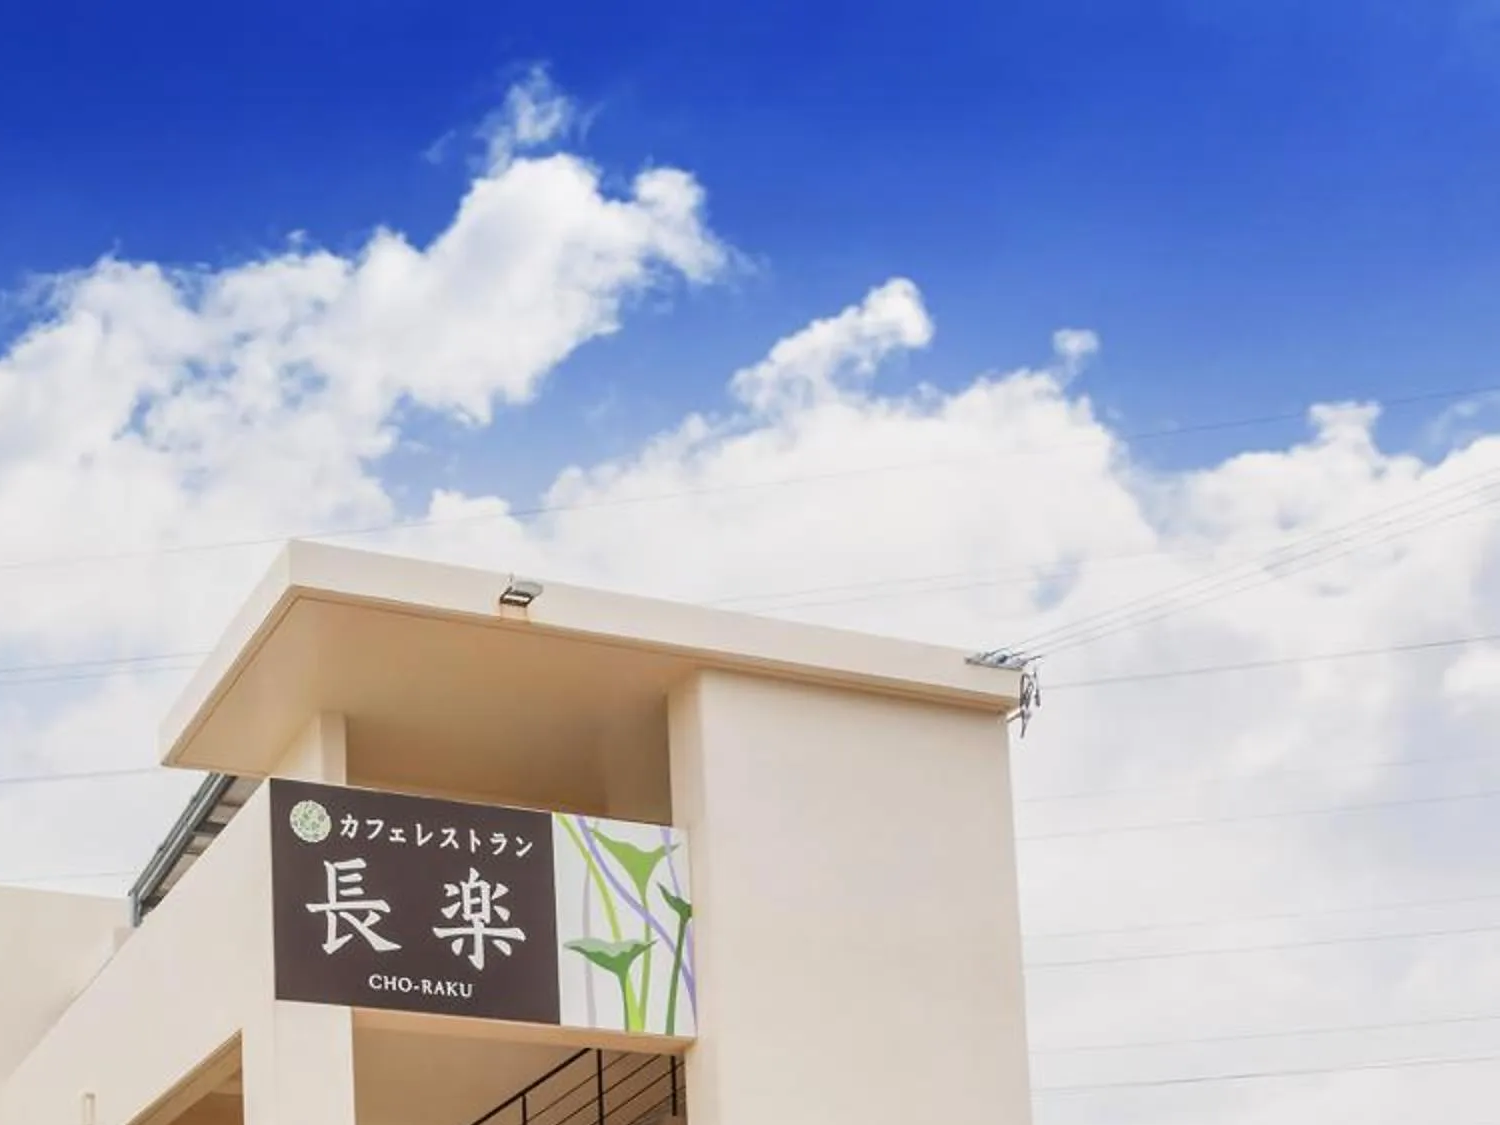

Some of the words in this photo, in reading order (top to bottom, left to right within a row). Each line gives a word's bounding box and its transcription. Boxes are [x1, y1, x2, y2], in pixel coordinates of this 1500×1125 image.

[339, 814, 533, 858] カフェレストラン
[305, 857, 527, 970] 長楽
[368, 973, 473, 998] CHO-RAKU
